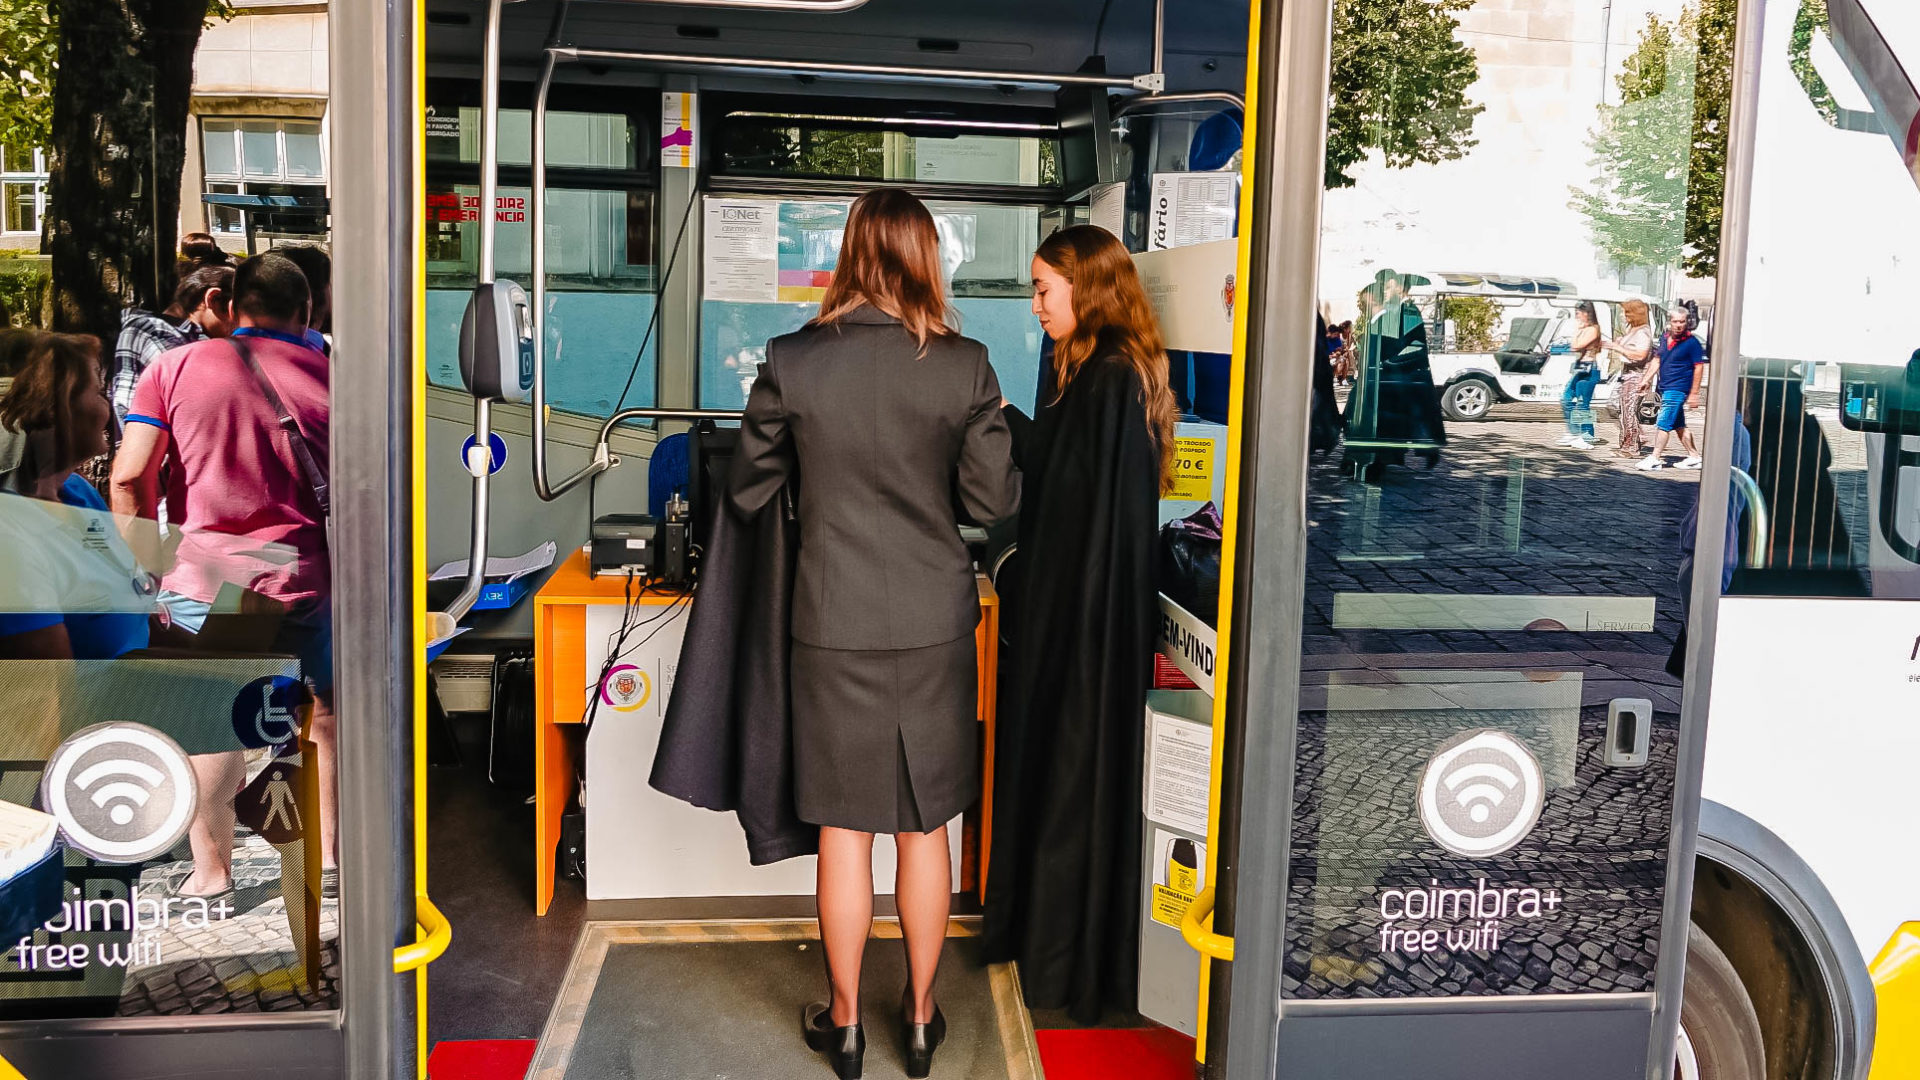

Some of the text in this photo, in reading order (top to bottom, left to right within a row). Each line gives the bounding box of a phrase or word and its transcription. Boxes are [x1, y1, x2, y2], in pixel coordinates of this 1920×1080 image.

[1380, 877, 1562, 920] coimbra+
[15, 932, 163, 970] free wifi
[1379, 920, 1499, 953] free wifi
